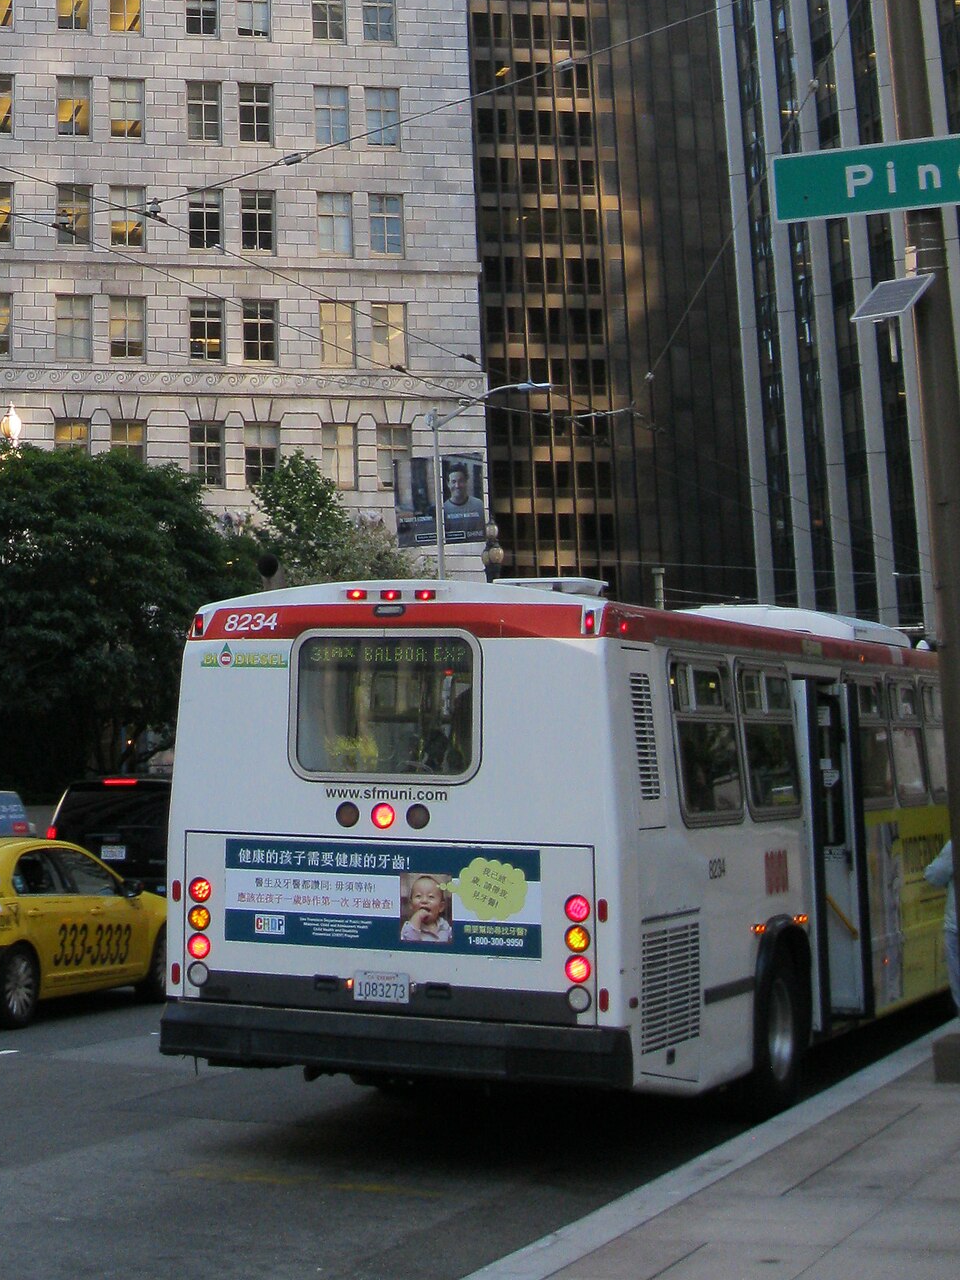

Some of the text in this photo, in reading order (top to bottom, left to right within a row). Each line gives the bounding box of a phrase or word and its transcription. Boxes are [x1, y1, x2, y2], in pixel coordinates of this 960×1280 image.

[845, 161, 960, 198] Pin
[224, 613, 278, 632] 8234
[326, 787, 447, 801] www.sfmuni.com
[709, 858, 726, 879] 8234
[53, 923, 132, 966] 333-3333
[357, 981, 406, 998] 1083273
